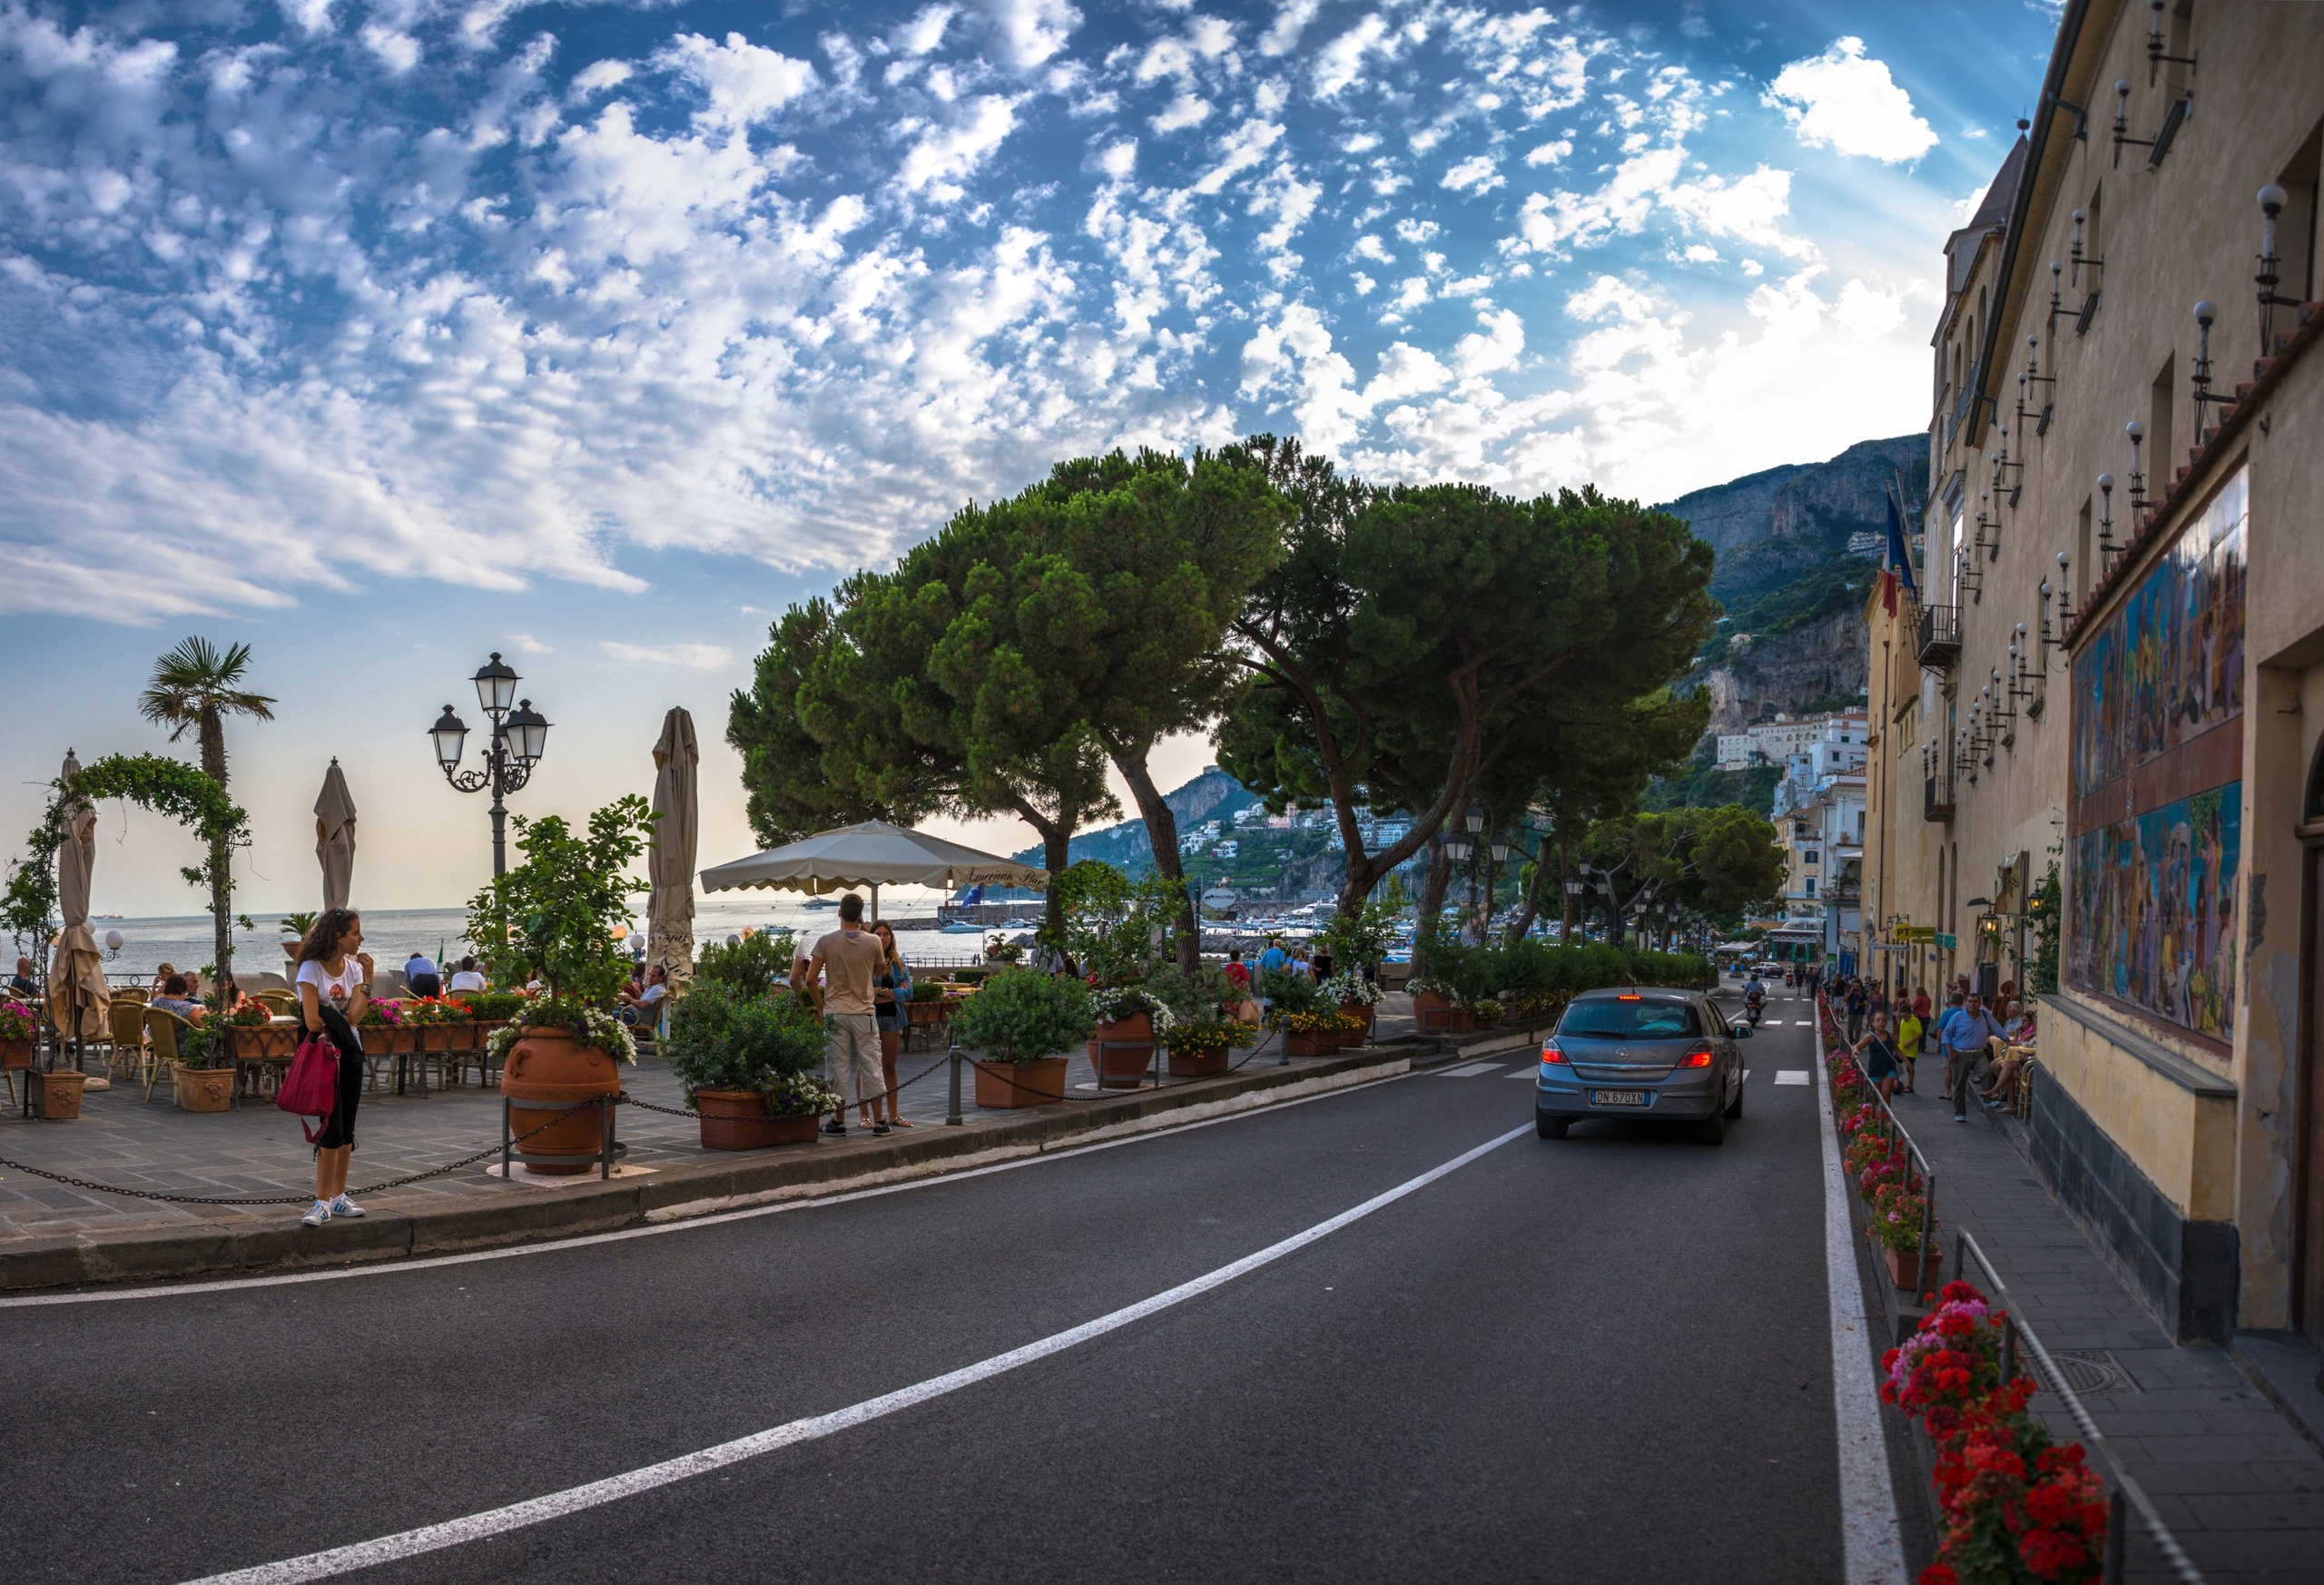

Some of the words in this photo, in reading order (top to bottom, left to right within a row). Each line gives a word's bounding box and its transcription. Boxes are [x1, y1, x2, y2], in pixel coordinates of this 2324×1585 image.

[960, 866, 1013, 883] American
[1019, 869, 1045, 886] Bar
[2009, 874, 2020, 899] Bar
[1896, 928, 1911, 937] PT
[1597, 1091, 1610, 1103] DN
[1612, 1092, 1644, 1104] 670XN
